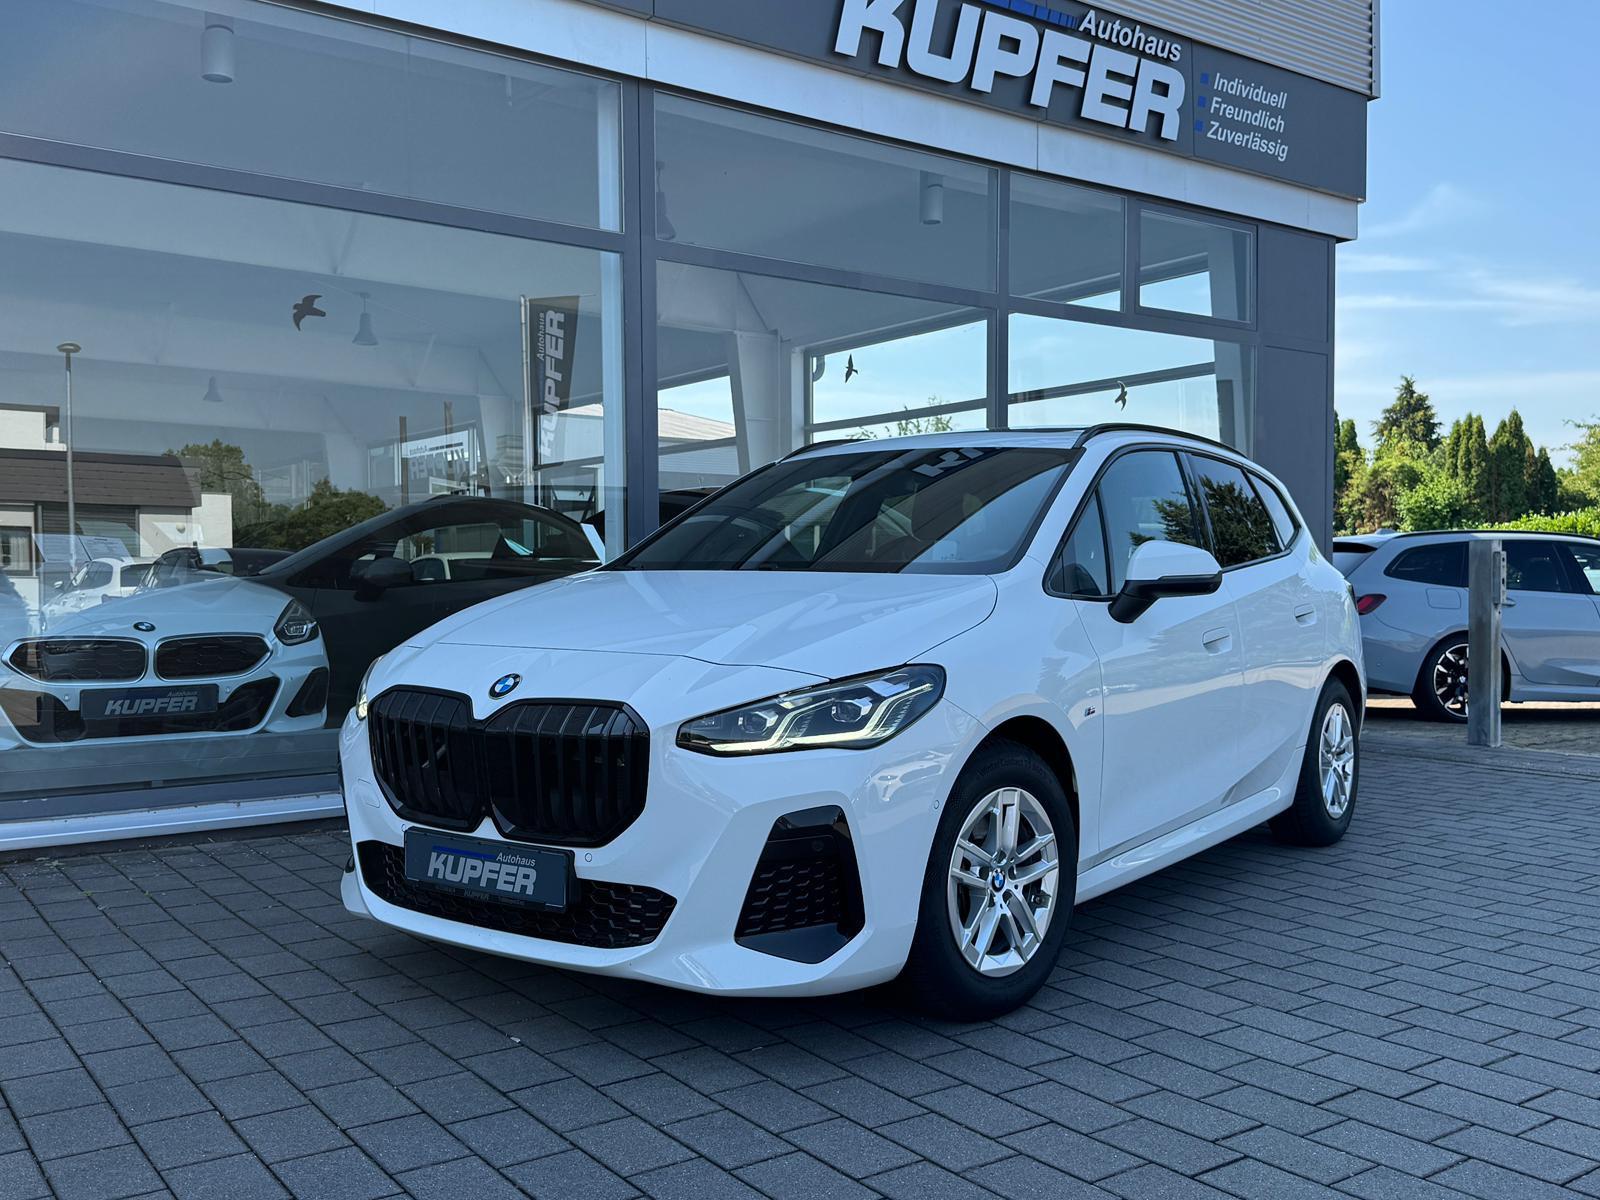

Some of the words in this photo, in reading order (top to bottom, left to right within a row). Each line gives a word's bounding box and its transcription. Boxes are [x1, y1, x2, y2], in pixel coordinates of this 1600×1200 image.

[1079, 10, 1182, 62] Autohaus
[835, 0, 1185, 141] KUPFER
[1213, 73, 1288, 109] Individuell
[1210, 97, 1285, 133] Freundlich
[1207, 121, 1289, 162] Zuverlässig
[104, 696, 199, 716] KUPFER
[427, 852, 537, 895] KUPFER
[496, 852, 536, 867] Autohaus
